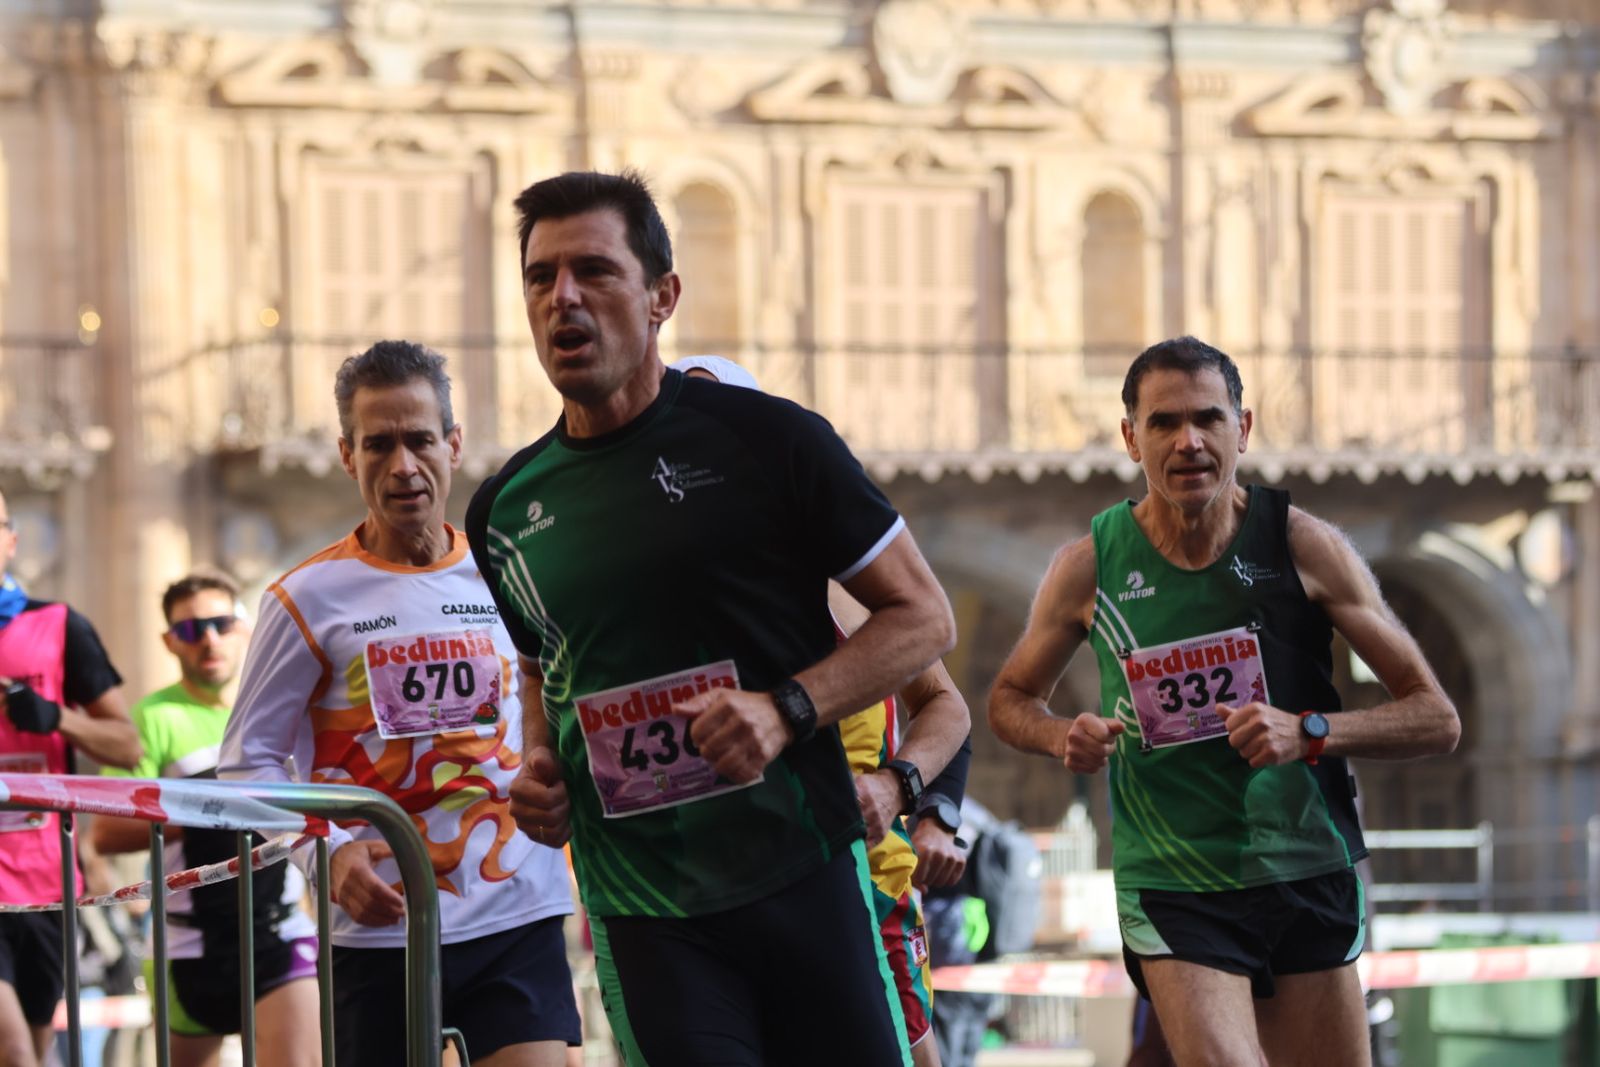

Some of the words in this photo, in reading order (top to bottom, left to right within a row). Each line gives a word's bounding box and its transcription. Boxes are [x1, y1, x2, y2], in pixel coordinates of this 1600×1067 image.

[518, 515, 555, 540] VIATOR
[1118, 586, 1156, 602] VIATOR
[353, 615, 397, 635] RAMÓN
[367, 631, 495, 668] bedunia
[1126, 637, 1258, 682] bedunia
[402, 661, 476, 703] 670
[1158, 666, 1238, 714] 332
